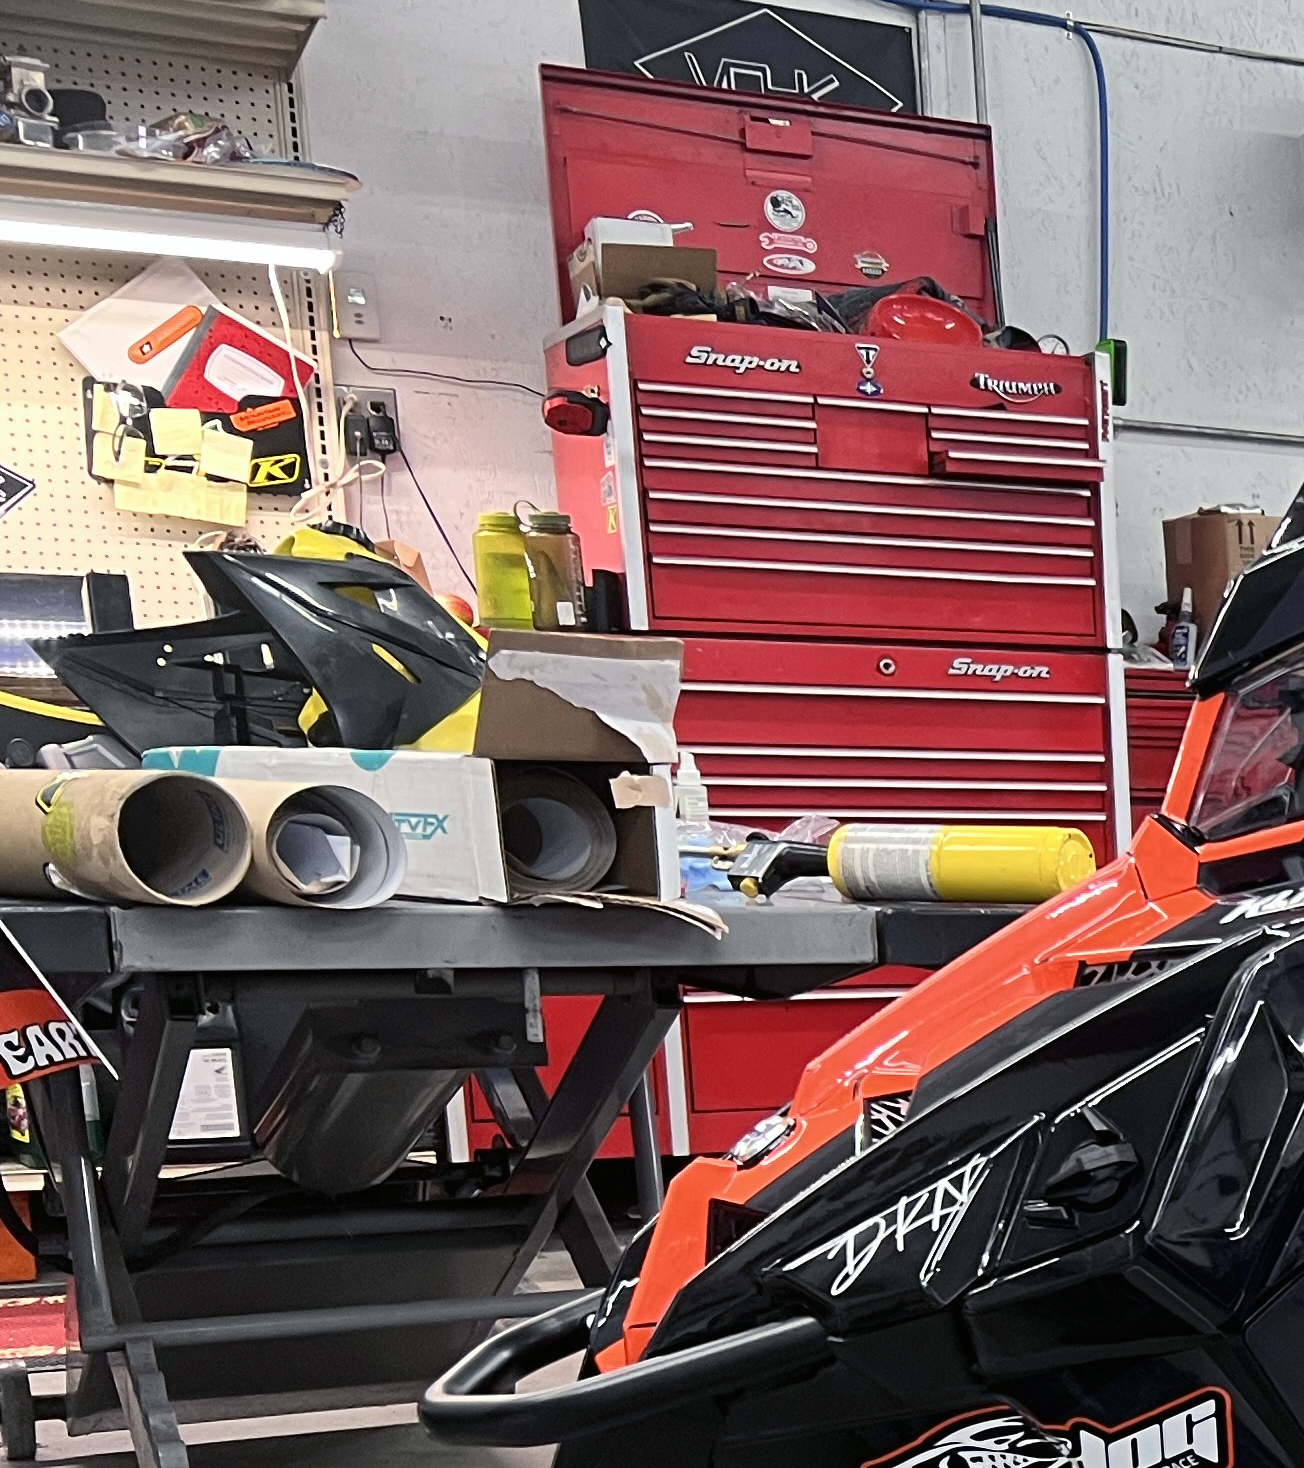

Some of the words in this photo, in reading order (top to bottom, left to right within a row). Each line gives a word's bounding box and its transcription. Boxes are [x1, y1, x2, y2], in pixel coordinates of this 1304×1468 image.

[684, 346, 801, 375] Snap-on
[973, 372, 1058, 397] TRIUMPH
[947, 657, 1051, 682] Snap-on
